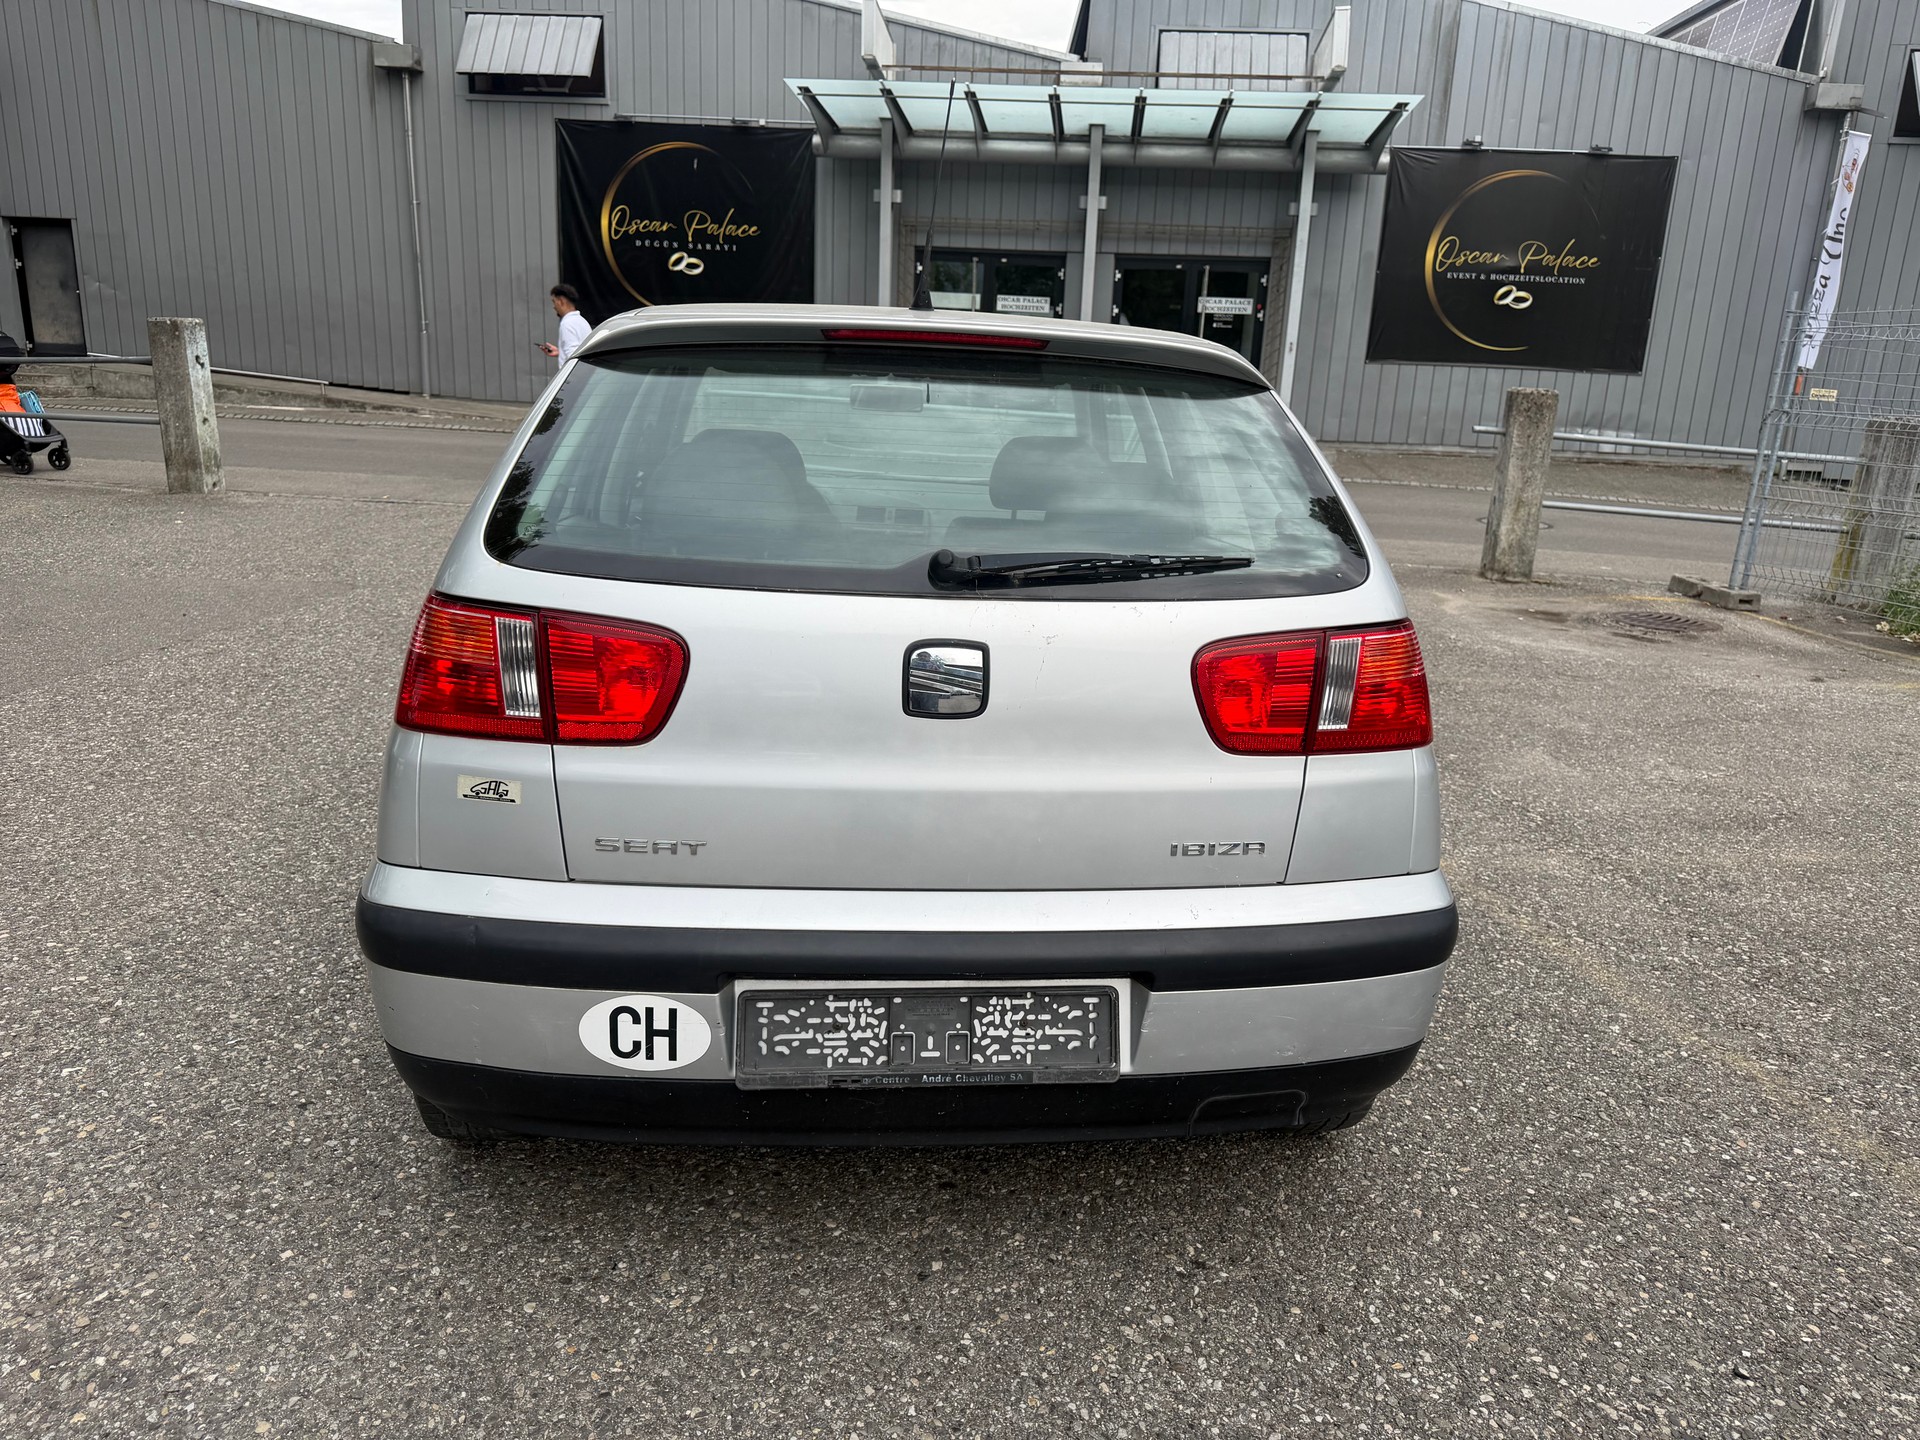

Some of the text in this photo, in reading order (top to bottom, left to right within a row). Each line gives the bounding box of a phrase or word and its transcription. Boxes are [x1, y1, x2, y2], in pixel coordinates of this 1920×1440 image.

[611, 204, 761, 244] Oscar Palace
[687, 242, 737, 252] SARAYI
[1435, 235, 1601, 275] Oscar Palace
[1447, 272, 1586, 285] EVENT & HOCHZEITSLOCATION
[997, 296, 1048, 305] OSCAR PALACE
[1001, 303, 1046, 312] HOCHZEITEN
[595, 837, 707, 855] SEAT
[1170, 841, 1266, 857] IBIZA
[607, 1005, 678, 1062] CH
[921, 1073, 952, 1083] André
[1010, 1073, 1024, 1082] SA
